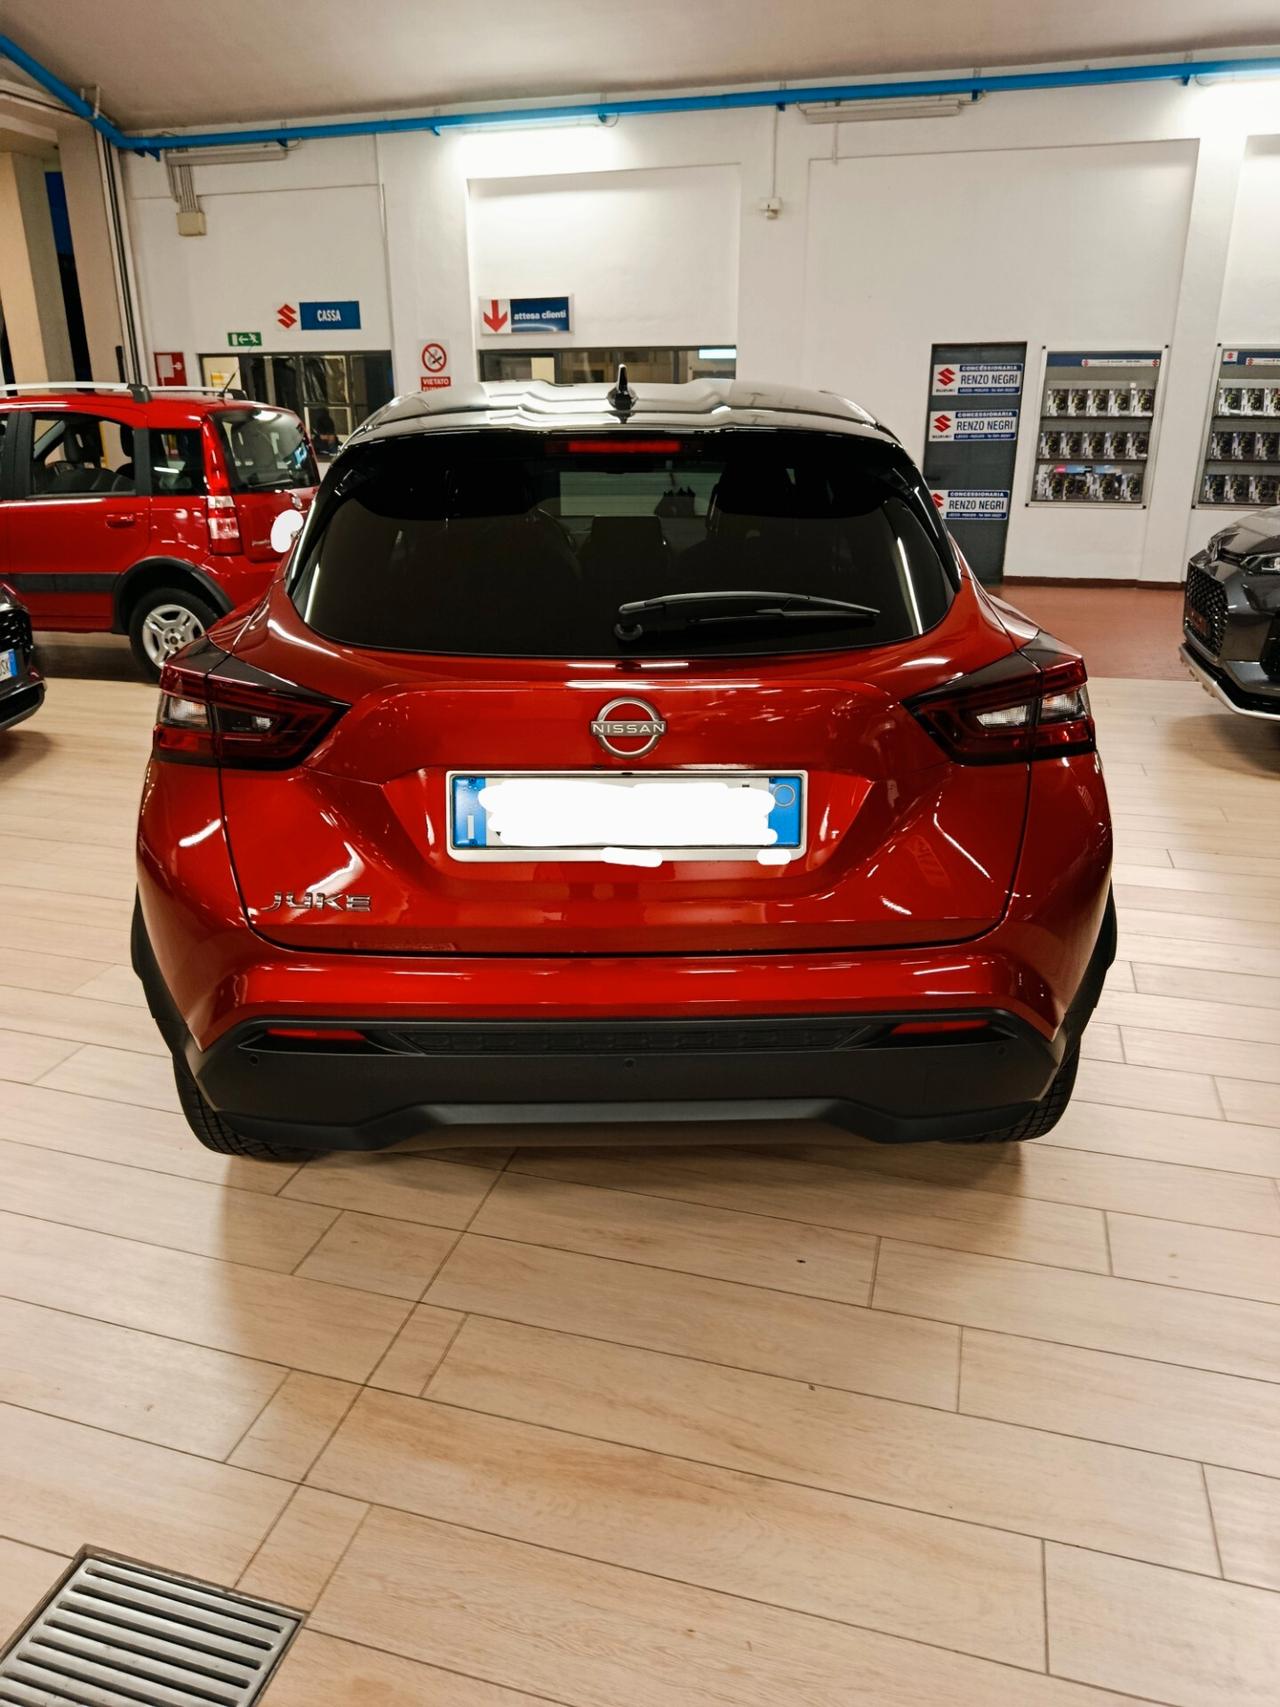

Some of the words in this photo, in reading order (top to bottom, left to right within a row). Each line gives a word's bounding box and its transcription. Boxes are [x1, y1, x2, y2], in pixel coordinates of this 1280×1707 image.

[316, 309, 342, 322] CASSA
[513, 312, 541, 320] attesa
[541, 309, 567, 319] clienti
[960, 374, 989, 385] RENZO
[991, 374, 1018, 385] NEGRI
[956, 420, 985, 431] RENZO
[987, 420, 1013, 431] NEGRI
[948, 500, 977, 510] RENZO
[978, 500, 1005, 510] NEGRI
[592, 723, 665, 734] NISSAN
[260, 892, 371, 912] JUKE
